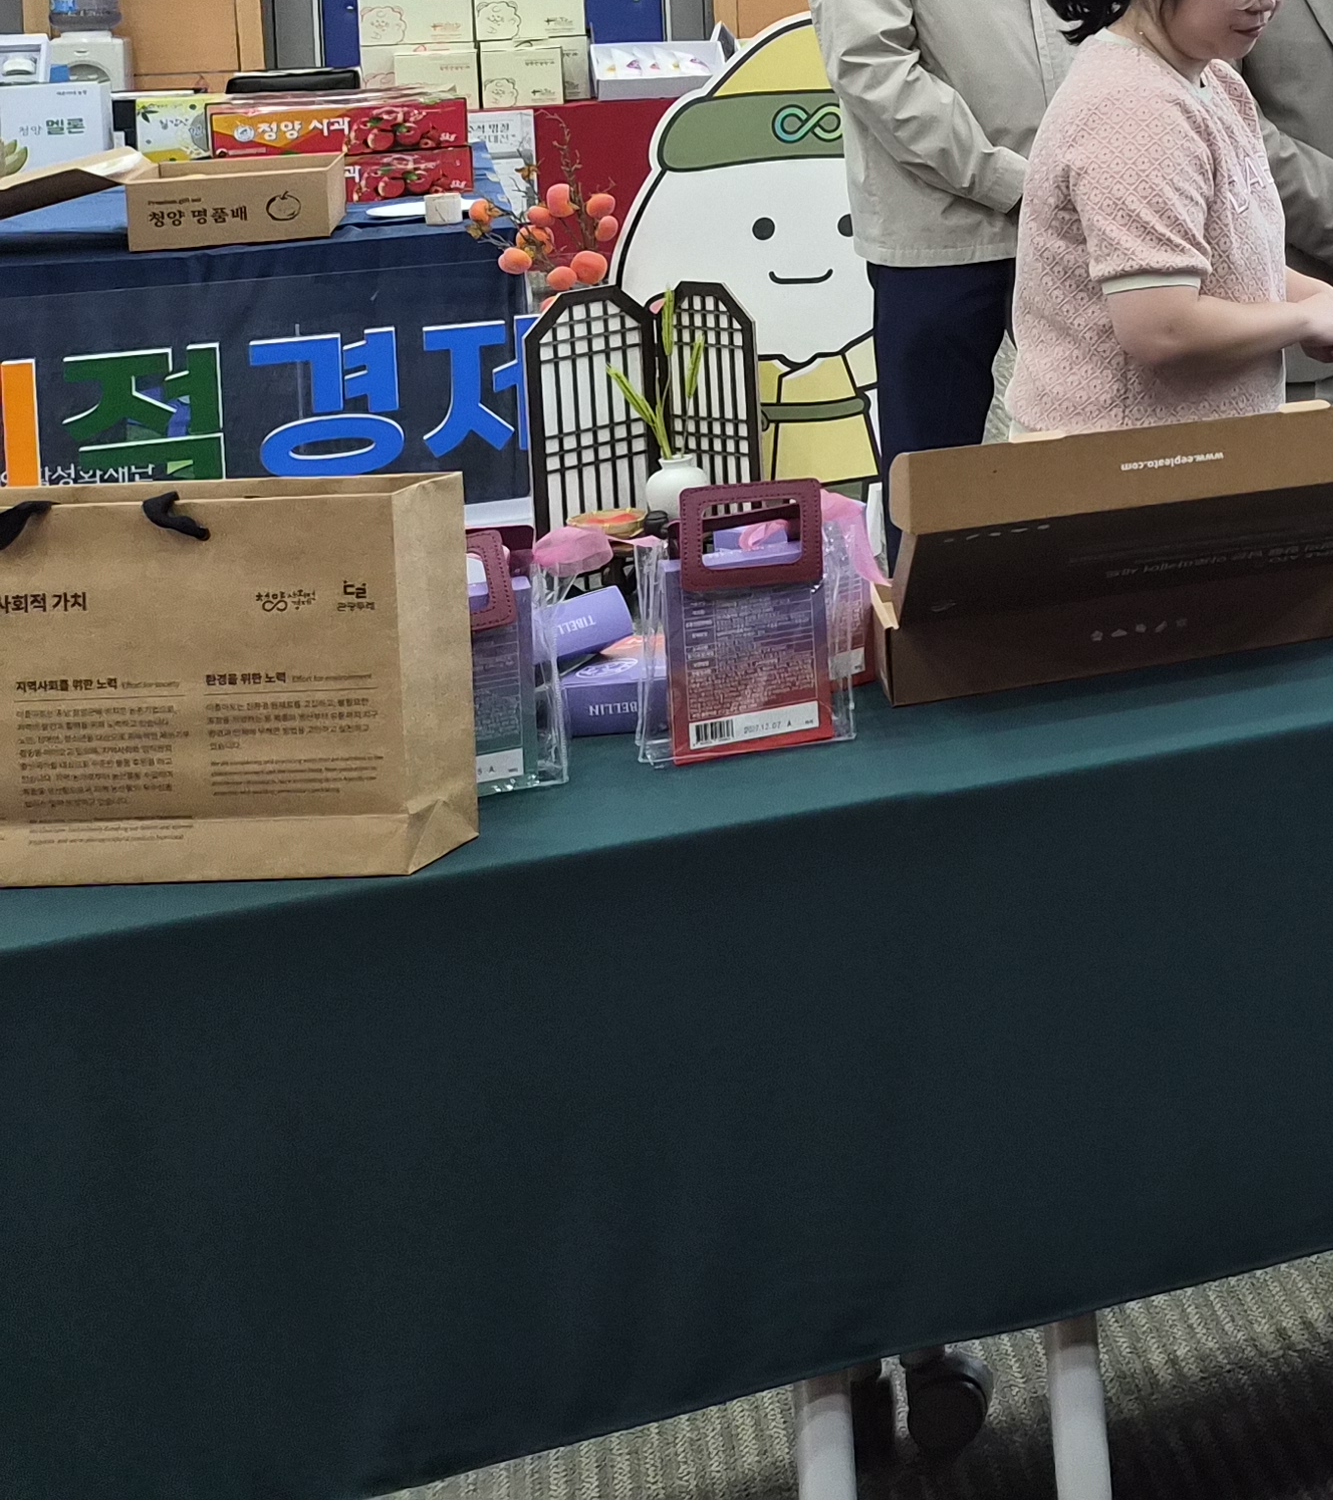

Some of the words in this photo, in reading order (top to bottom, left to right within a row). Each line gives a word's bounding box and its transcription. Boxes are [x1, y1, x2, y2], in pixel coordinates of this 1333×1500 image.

[46, 118, 85, 135] 멜론
[310, 117, 351, 136] 사과
[149, 209, 185, 228] 청양
[191, 205, 248, 225] 명품배
[1120, 451, 1224, 472] www.eepleato.com
[0, 593, 47, 613] 사회적
[52, 592, 87, 612] 가치
[557, 615, 596, 635] TIBELL
[16, 679, 69, 693] 지역사회를
[72, 678, 94, 691] 위한
[96, 677, 118, 690] 노력
[205, 673, 238, 686] 환경을
[240, 672, 262, 685] 위한
[264, 672, 286, 684] 노력
[589, 701, 638, 716] BELLIN
